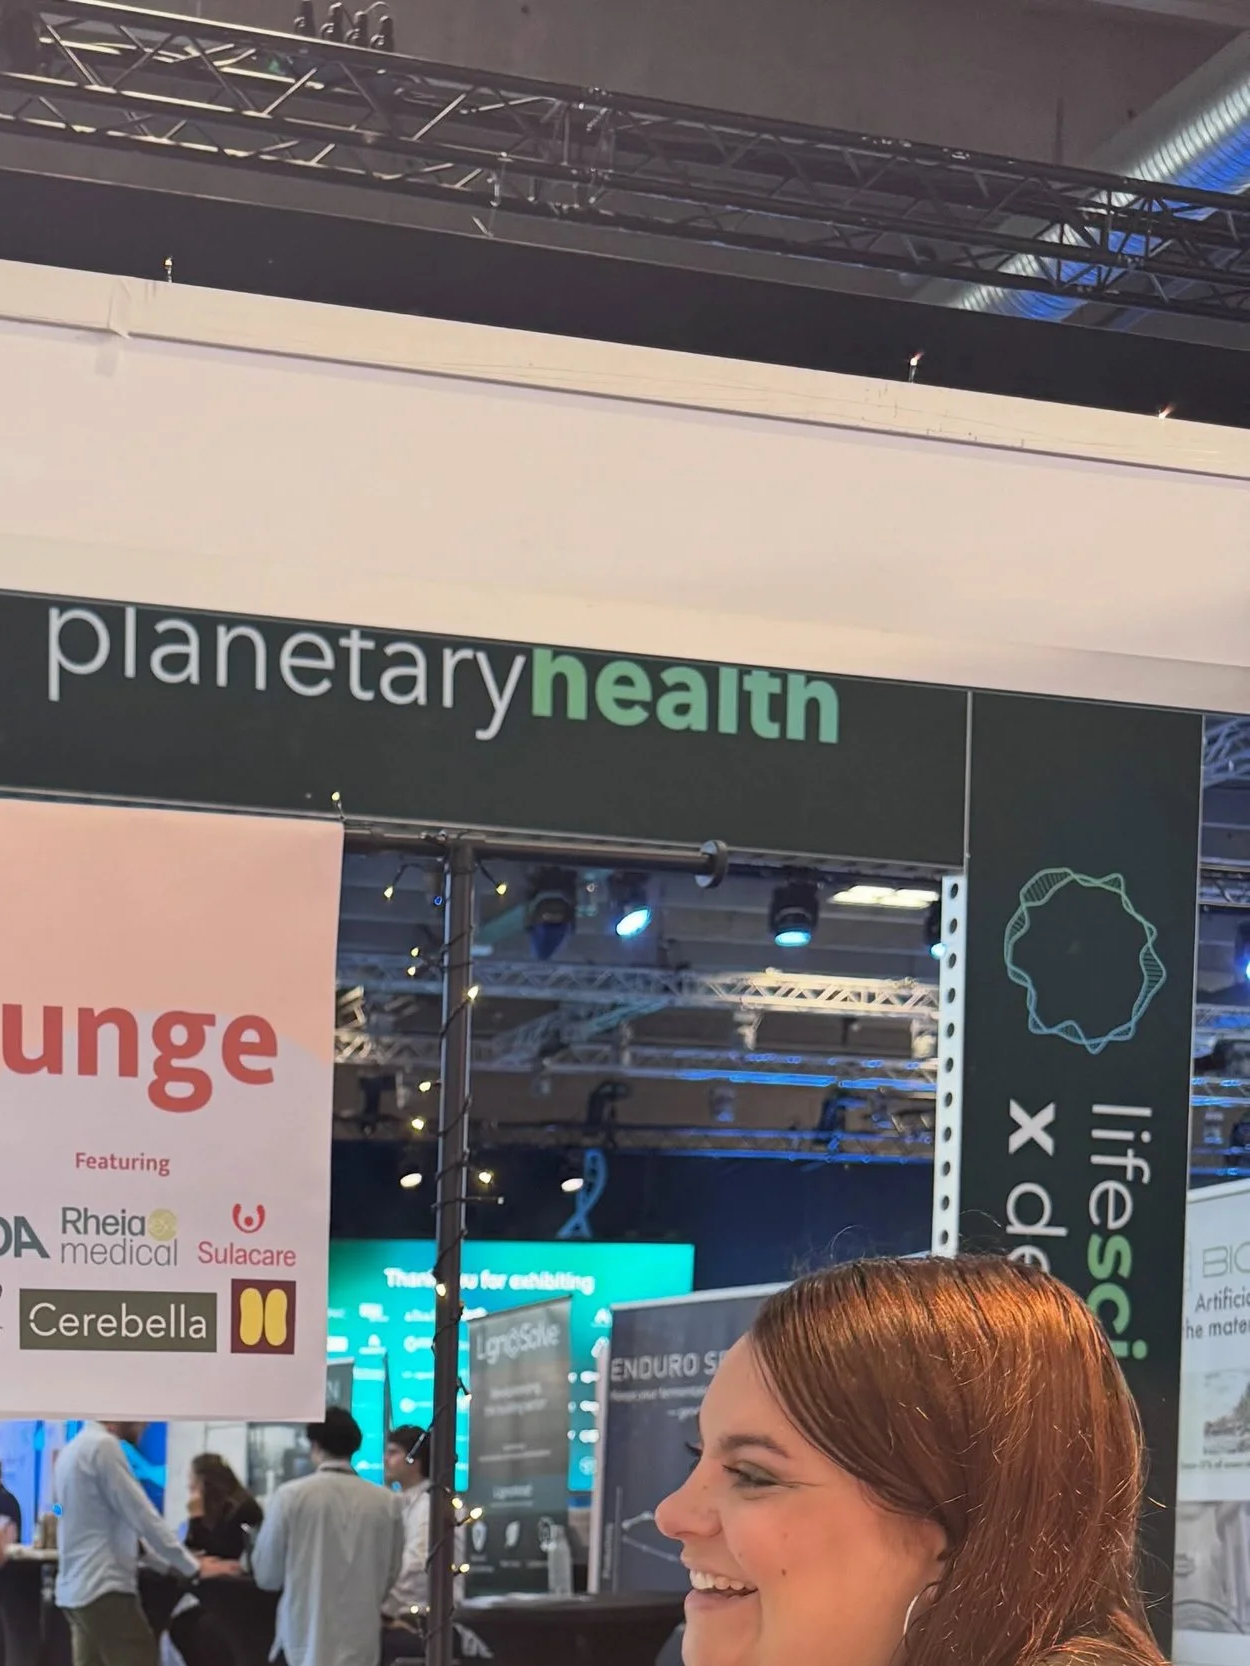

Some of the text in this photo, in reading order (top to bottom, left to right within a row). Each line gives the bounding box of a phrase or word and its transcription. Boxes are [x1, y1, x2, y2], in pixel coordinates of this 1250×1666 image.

[1008, 1098, 1055, 1156] x
[75, 1152, 170, 1177] Featuring
[61, 1206, 146, 1237] Rheia
[61, 1238, 178, 1267] medical
[197, 1241, 297, 1267] Sulacare
[460, 1271, 478, 1290] ou
[480, 1270, 507, 1290] for
[509, 1271, 595, 1295] exhibiting
[29, 1302, 207, 1340] Cerebella
[1209, 1315, 1250, 1338] mate
[610, 1352, 701, 1381] ENDURO
